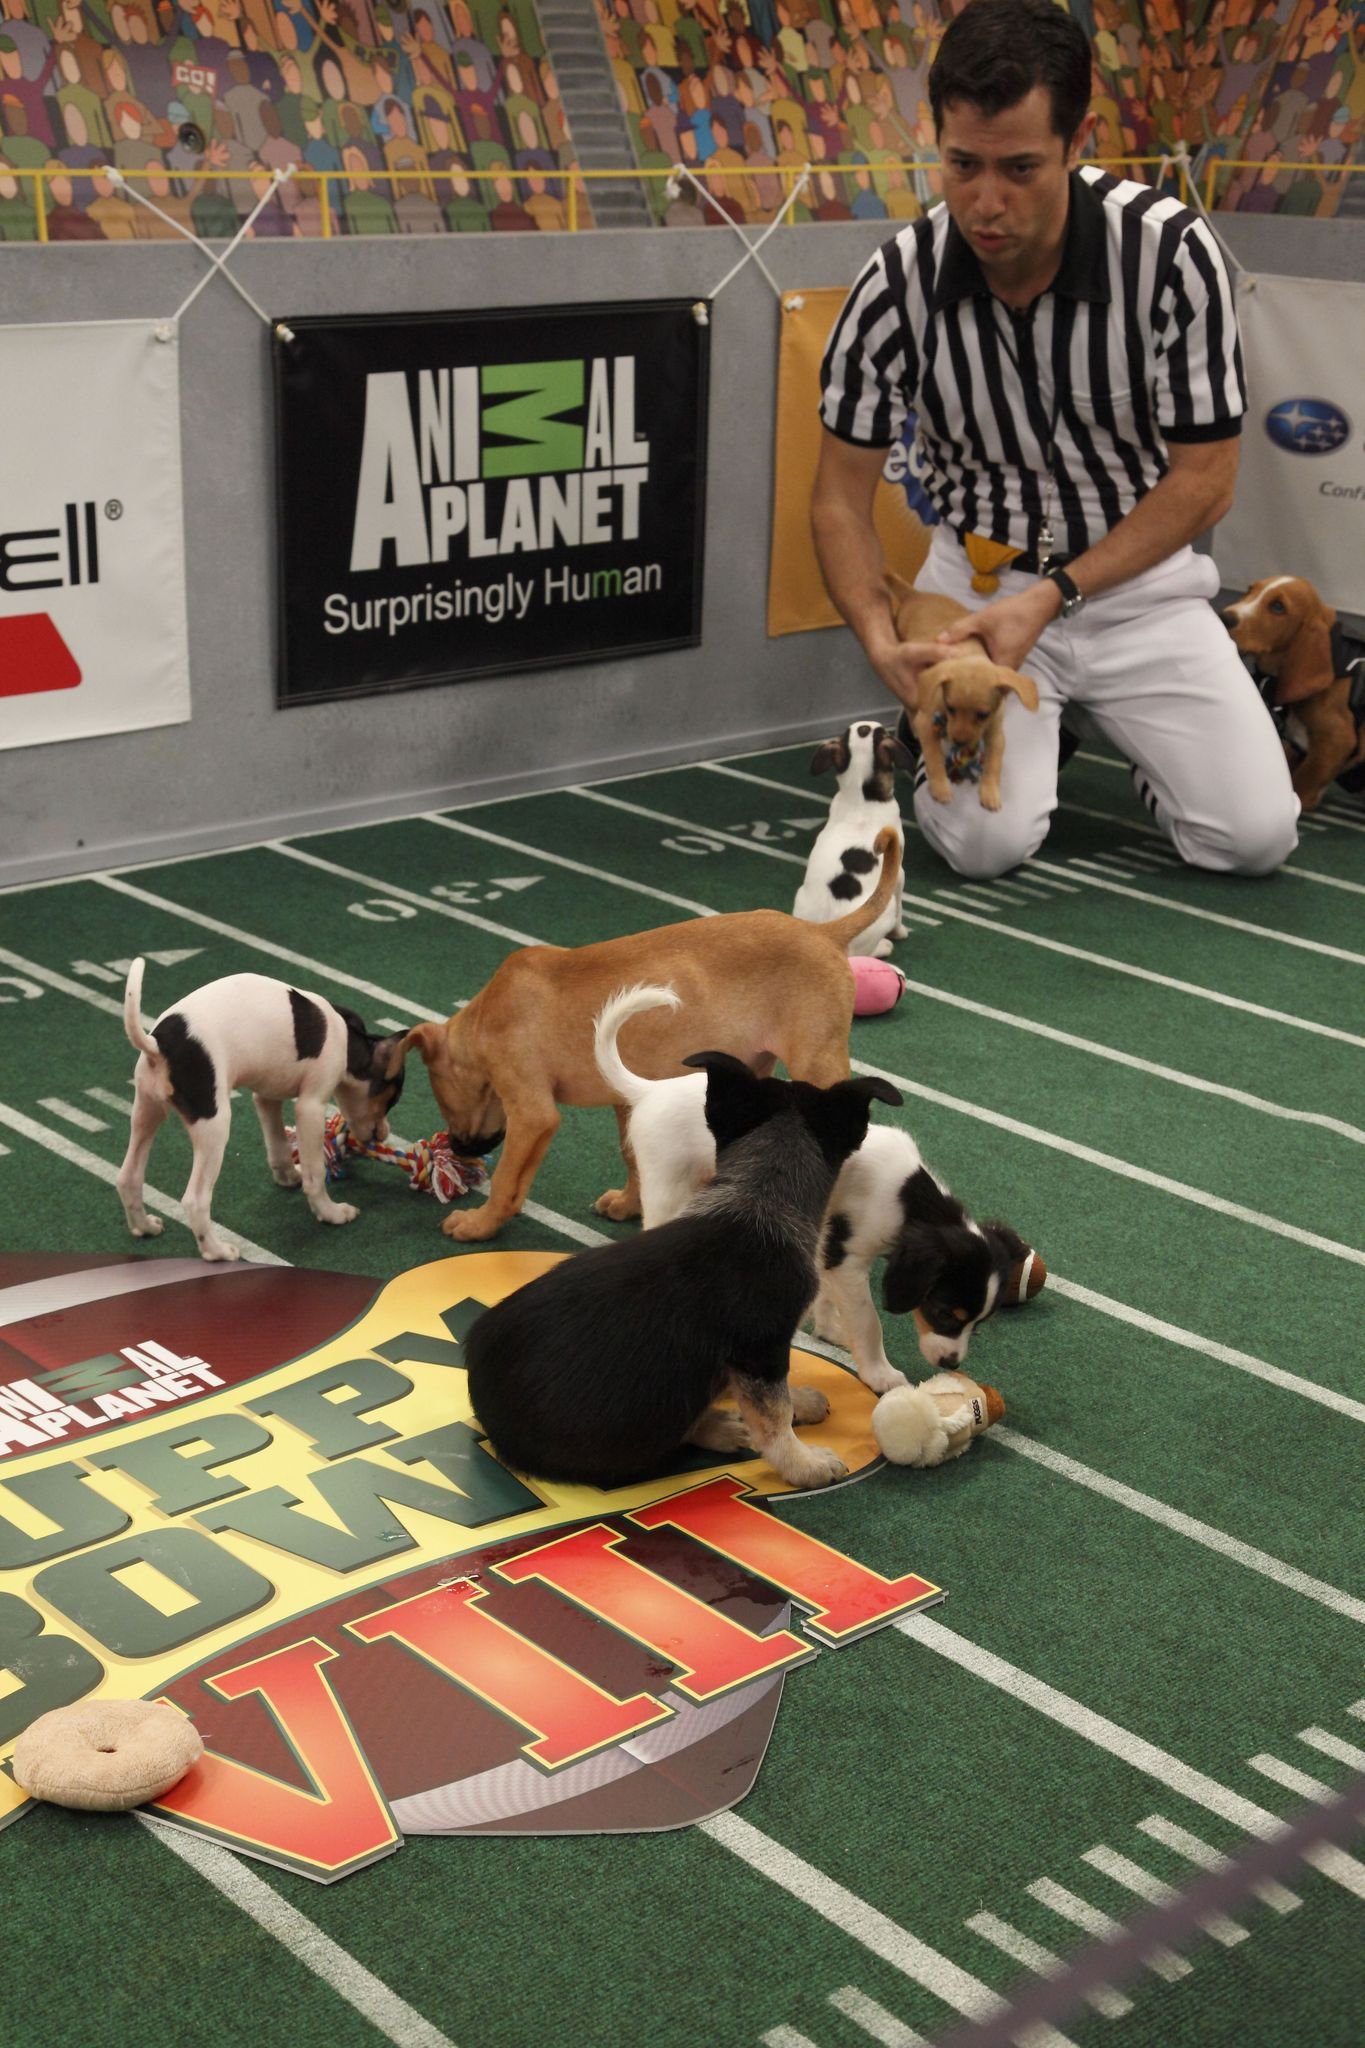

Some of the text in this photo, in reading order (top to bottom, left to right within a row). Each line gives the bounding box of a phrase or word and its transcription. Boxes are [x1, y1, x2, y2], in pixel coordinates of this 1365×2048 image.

[175, 65, 214, 94] GO!
[350, 355, 650, 572] ANIMAL
[429, 466, 650, 564] PLANET
[323, 562, 662, 636] Surprisingly Human
[28, 1362, 227, 1439] PLANET
[0, 1421, 764, 1746] BOW
